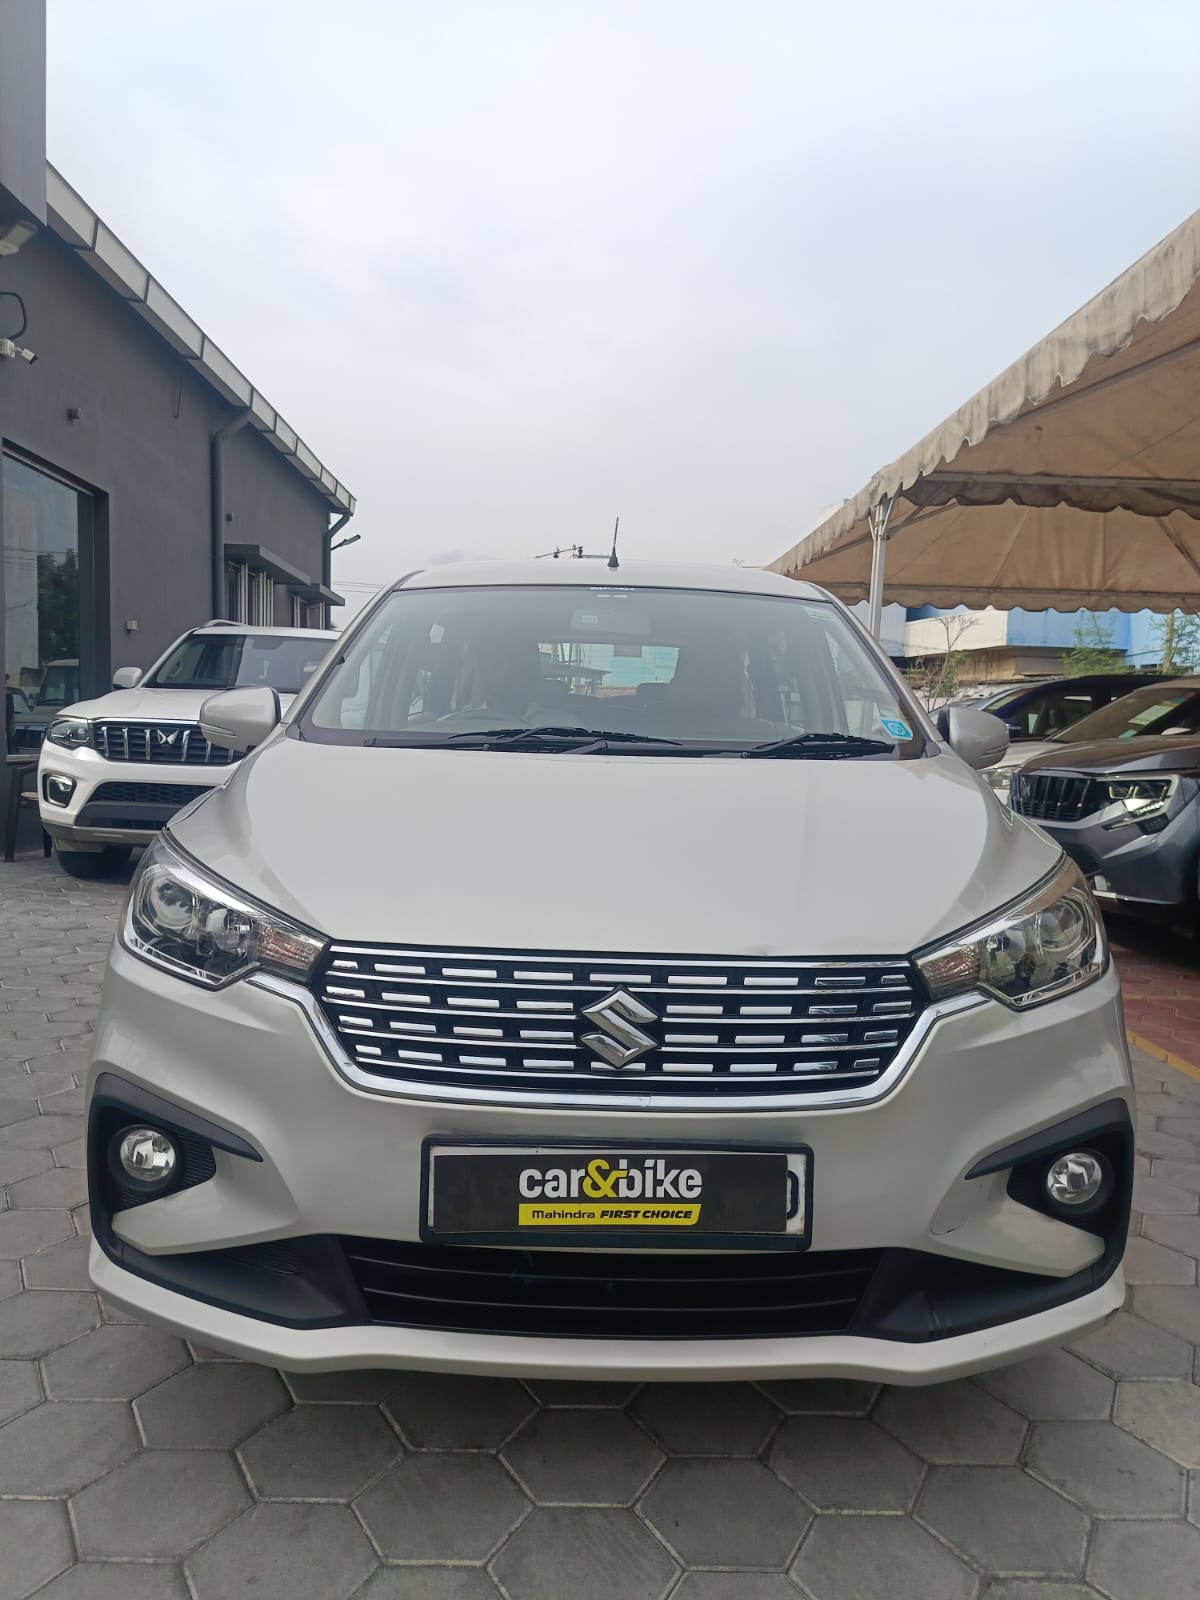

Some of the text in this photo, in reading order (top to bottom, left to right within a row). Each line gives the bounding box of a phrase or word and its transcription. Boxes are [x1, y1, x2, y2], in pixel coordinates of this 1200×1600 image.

[518, 1158, 703, 1199] car&bike
[531, 1210, 693, 1219] Mahindra FIRST CHOICE
